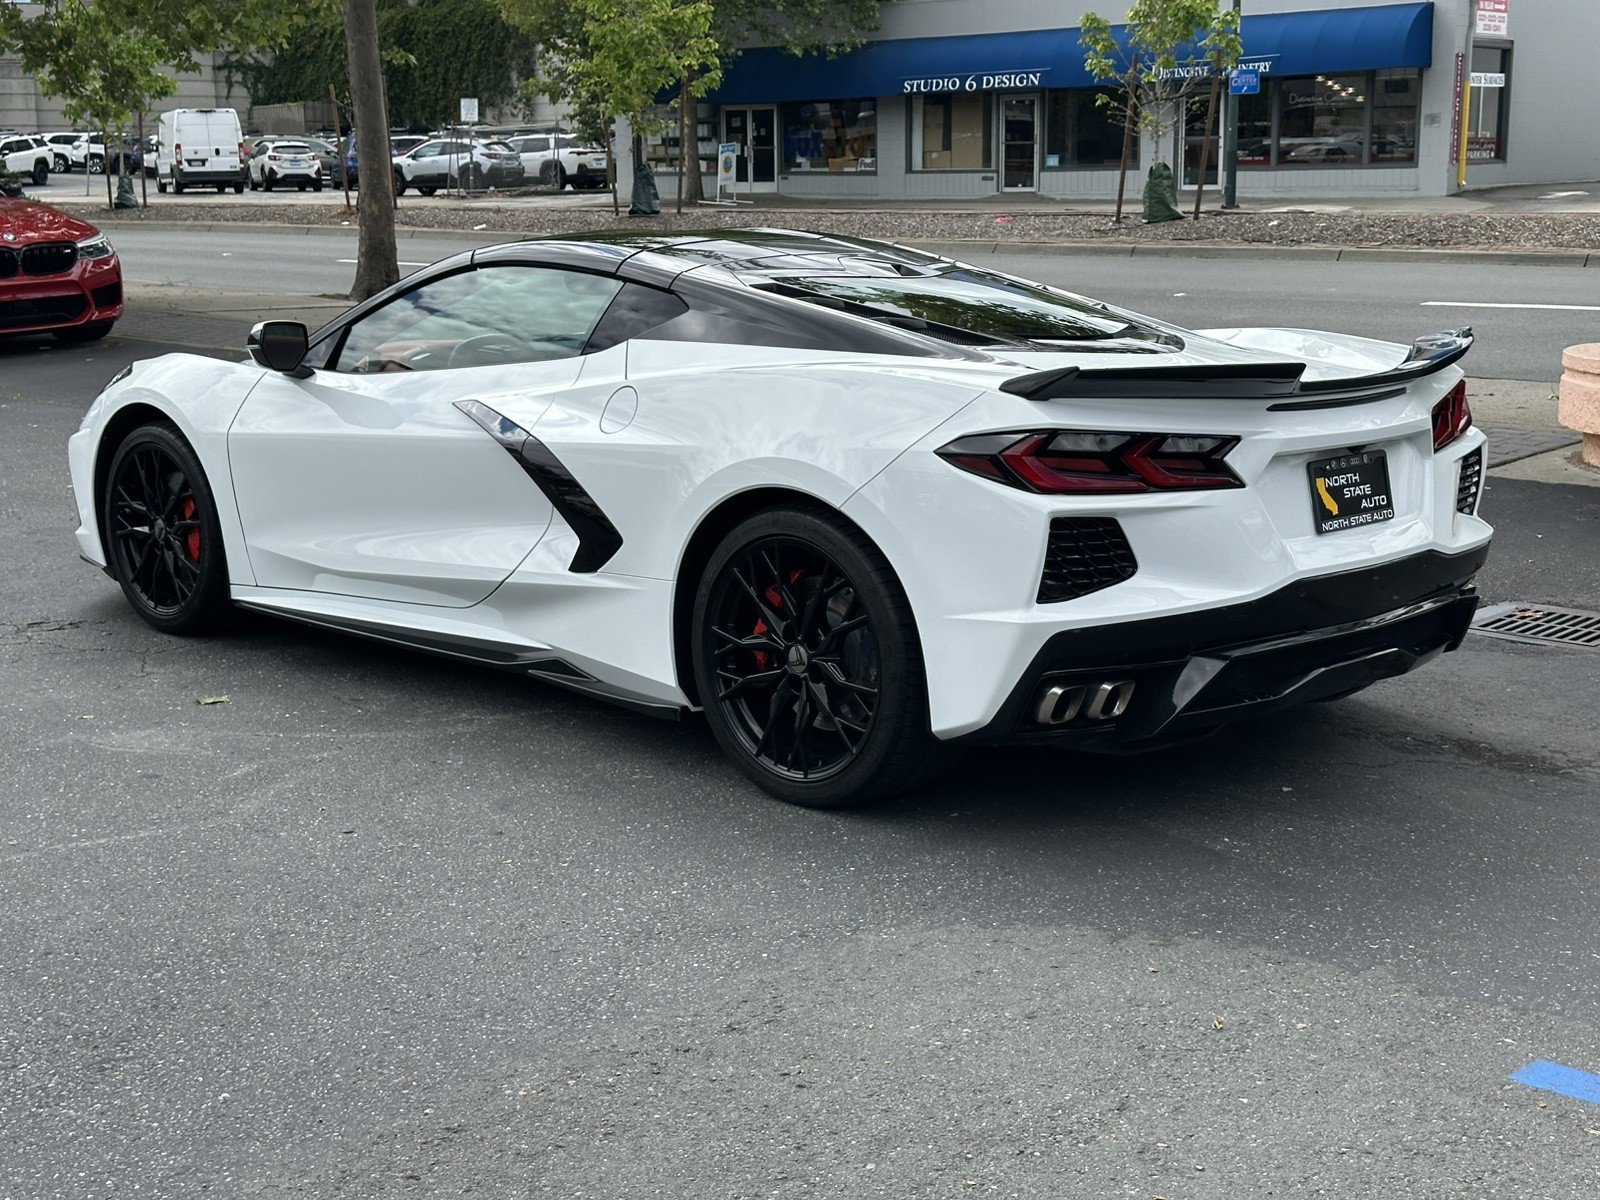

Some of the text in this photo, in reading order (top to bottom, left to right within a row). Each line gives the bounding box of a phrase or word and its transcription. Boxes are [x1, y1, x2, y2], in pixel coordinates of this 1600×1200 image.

[904, 73, 1041, 93] STUDIO 6 DESIGN
[1324, 472, 1360, 488] NORTH
[1343, 484, 1372, 498] STATE
[1361, 495, 1387, 509] AUTO
[1322, 509, 1393, 531] NORTH STATE AUTO
